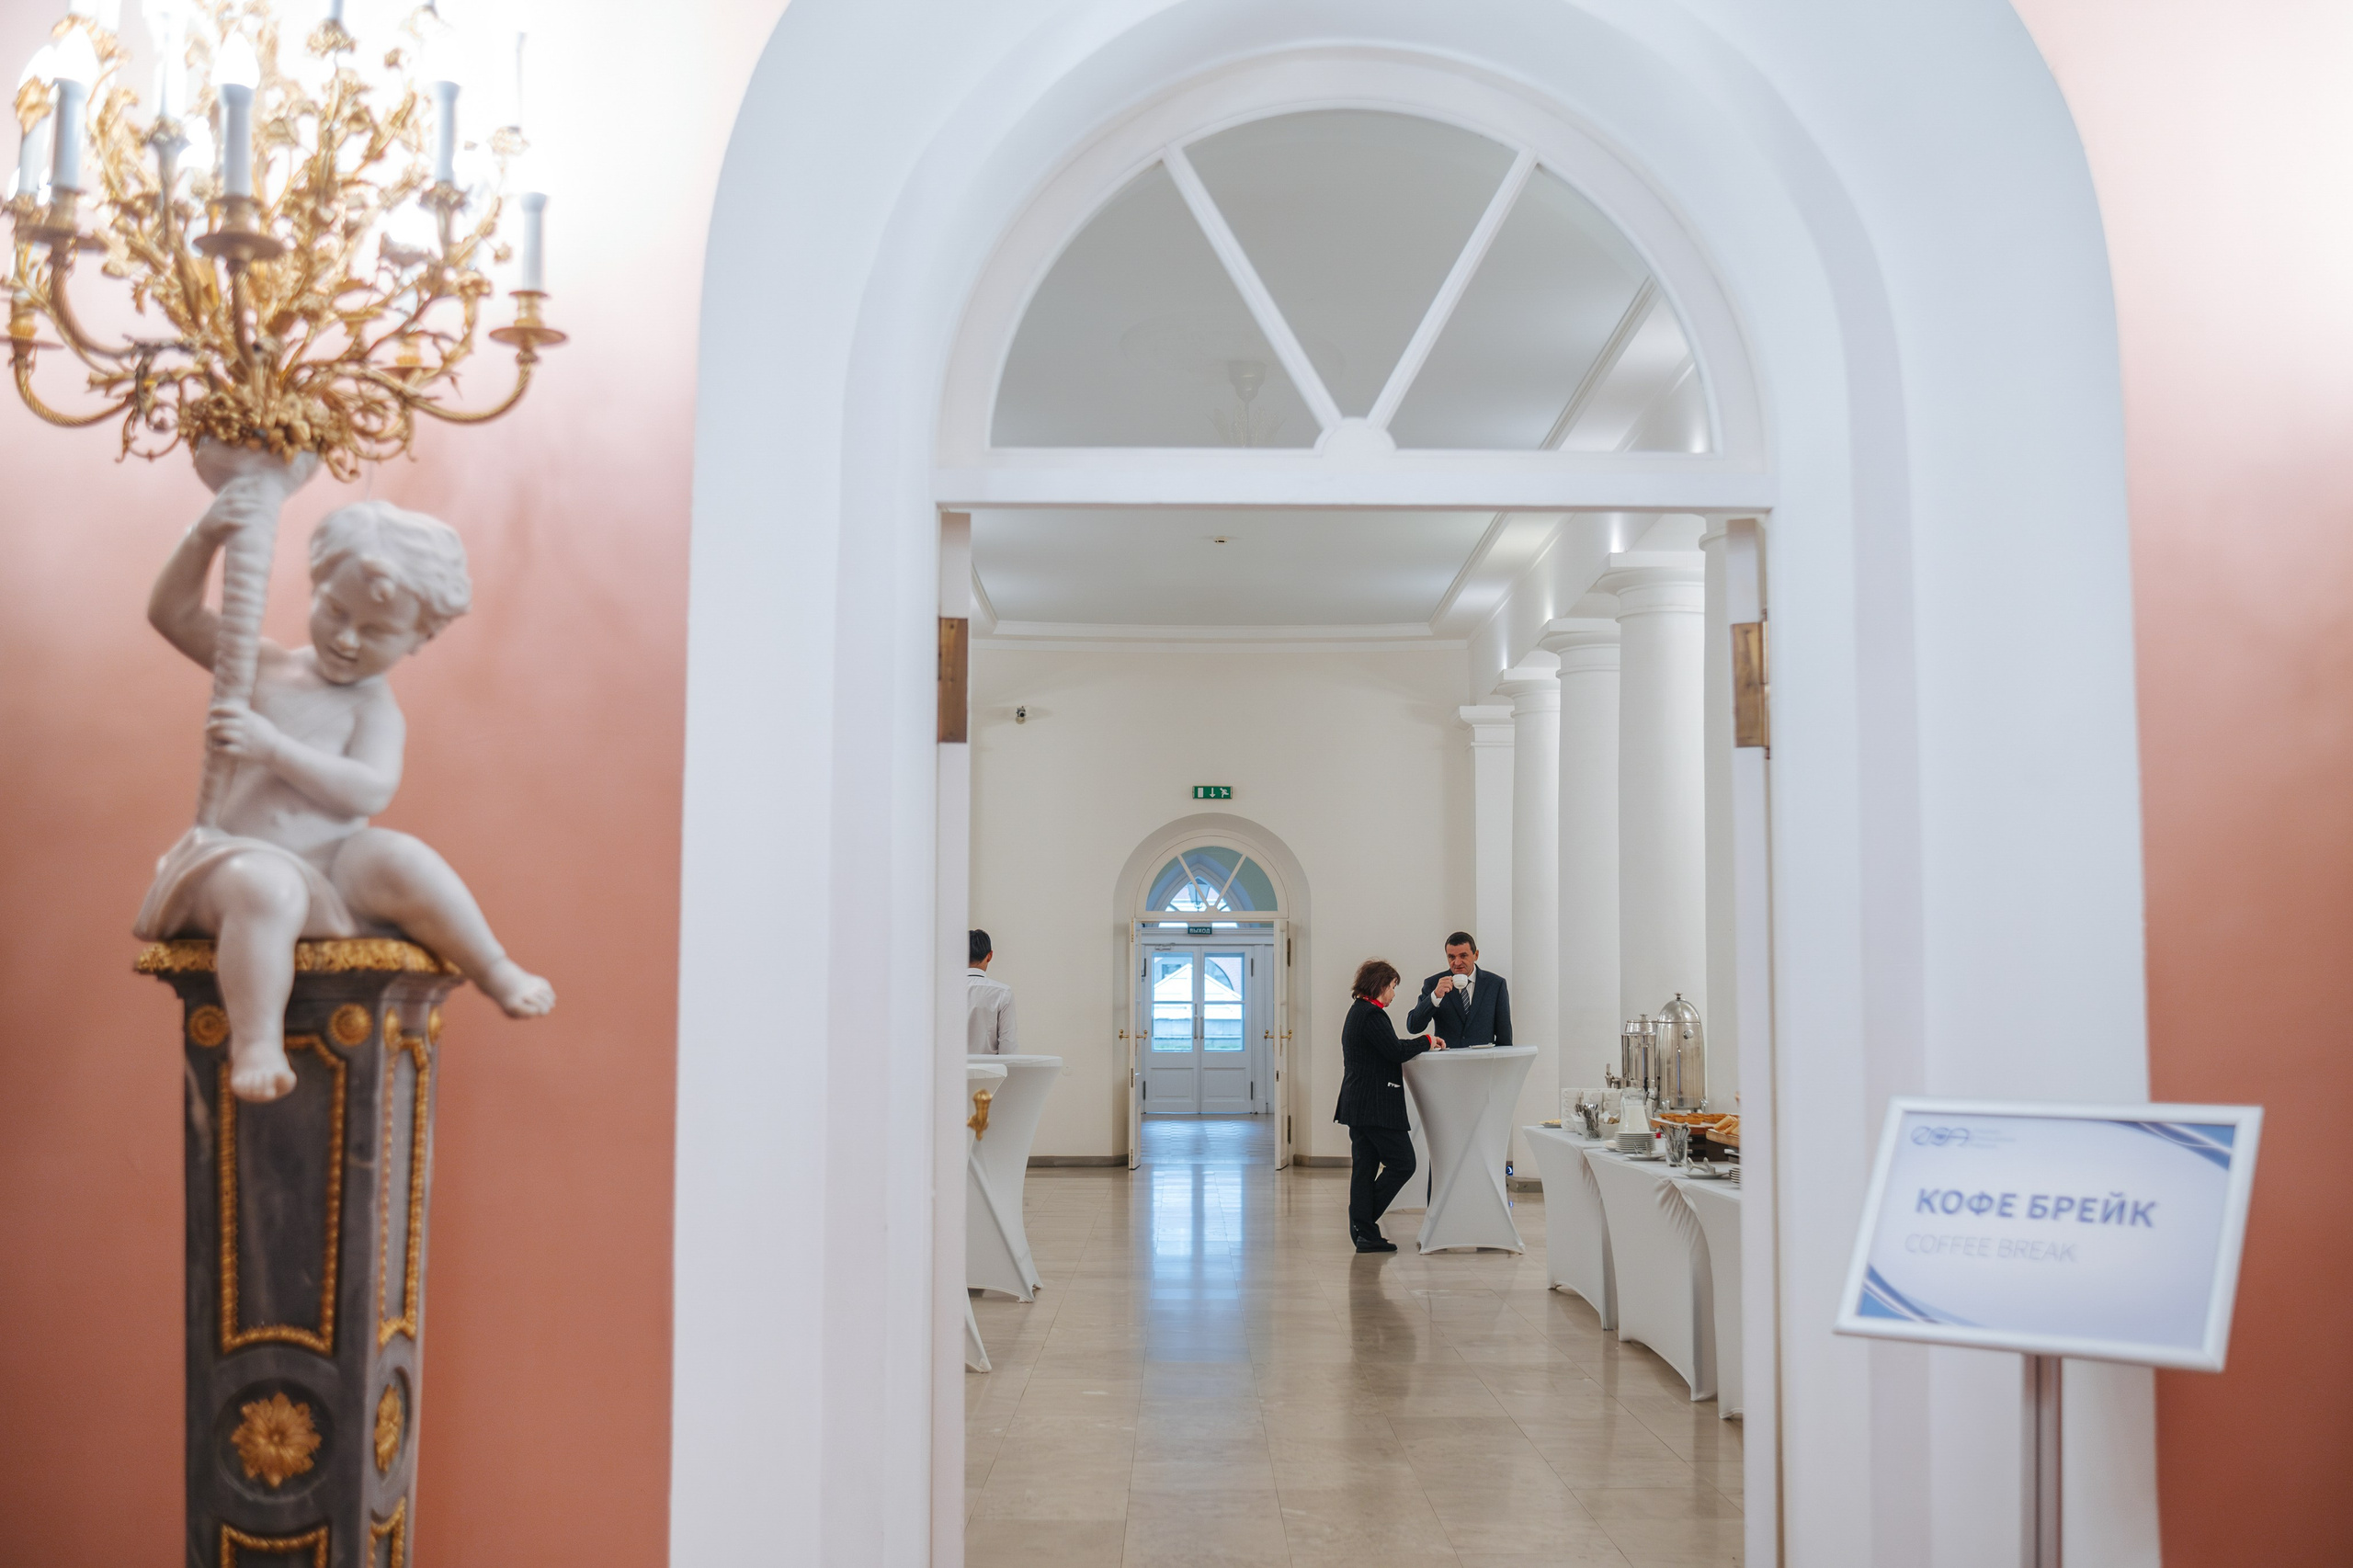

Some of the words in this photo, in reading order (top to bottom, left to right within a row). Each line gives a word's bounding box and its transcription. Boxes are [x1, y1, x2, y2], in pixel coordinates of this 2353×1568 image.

[1915, 1188, 2017, 1218] КОФЕ
[2026, 1191, 2156, 1228] БРЕЙК
[1904, 1233, 1991, 1258] COFFEE
[1996, 1238, 2078, 1262] BREAK
